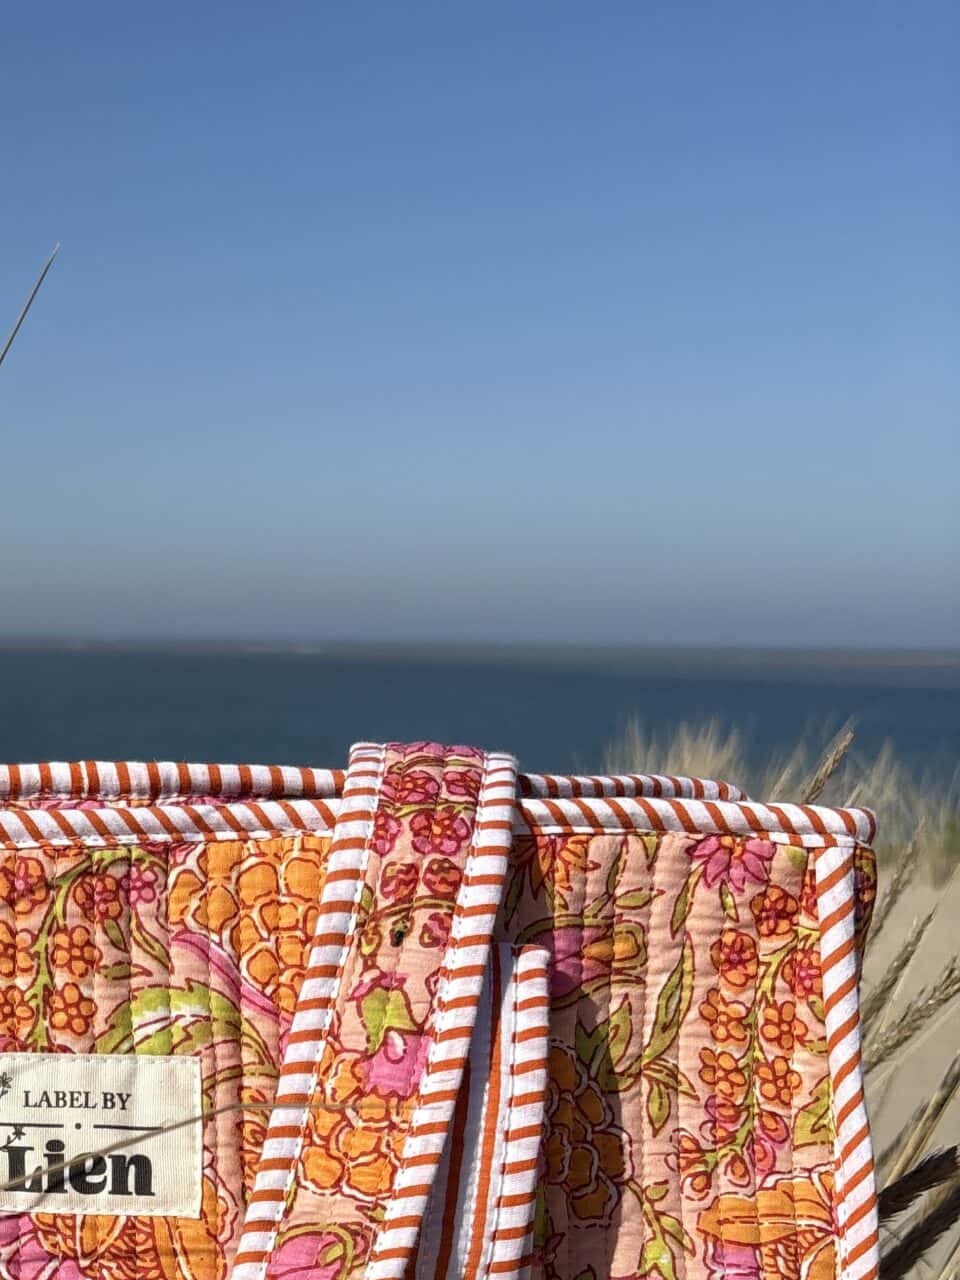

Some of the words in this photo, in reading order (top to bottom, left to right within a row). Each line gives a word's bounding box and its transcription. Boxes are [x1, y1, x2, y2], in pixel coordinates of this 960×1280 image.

[23, 1090, 97, 1110] LABEL
[101, 1091, 132, 1111] BY
[4, 1139, 156, 1197] Lien
